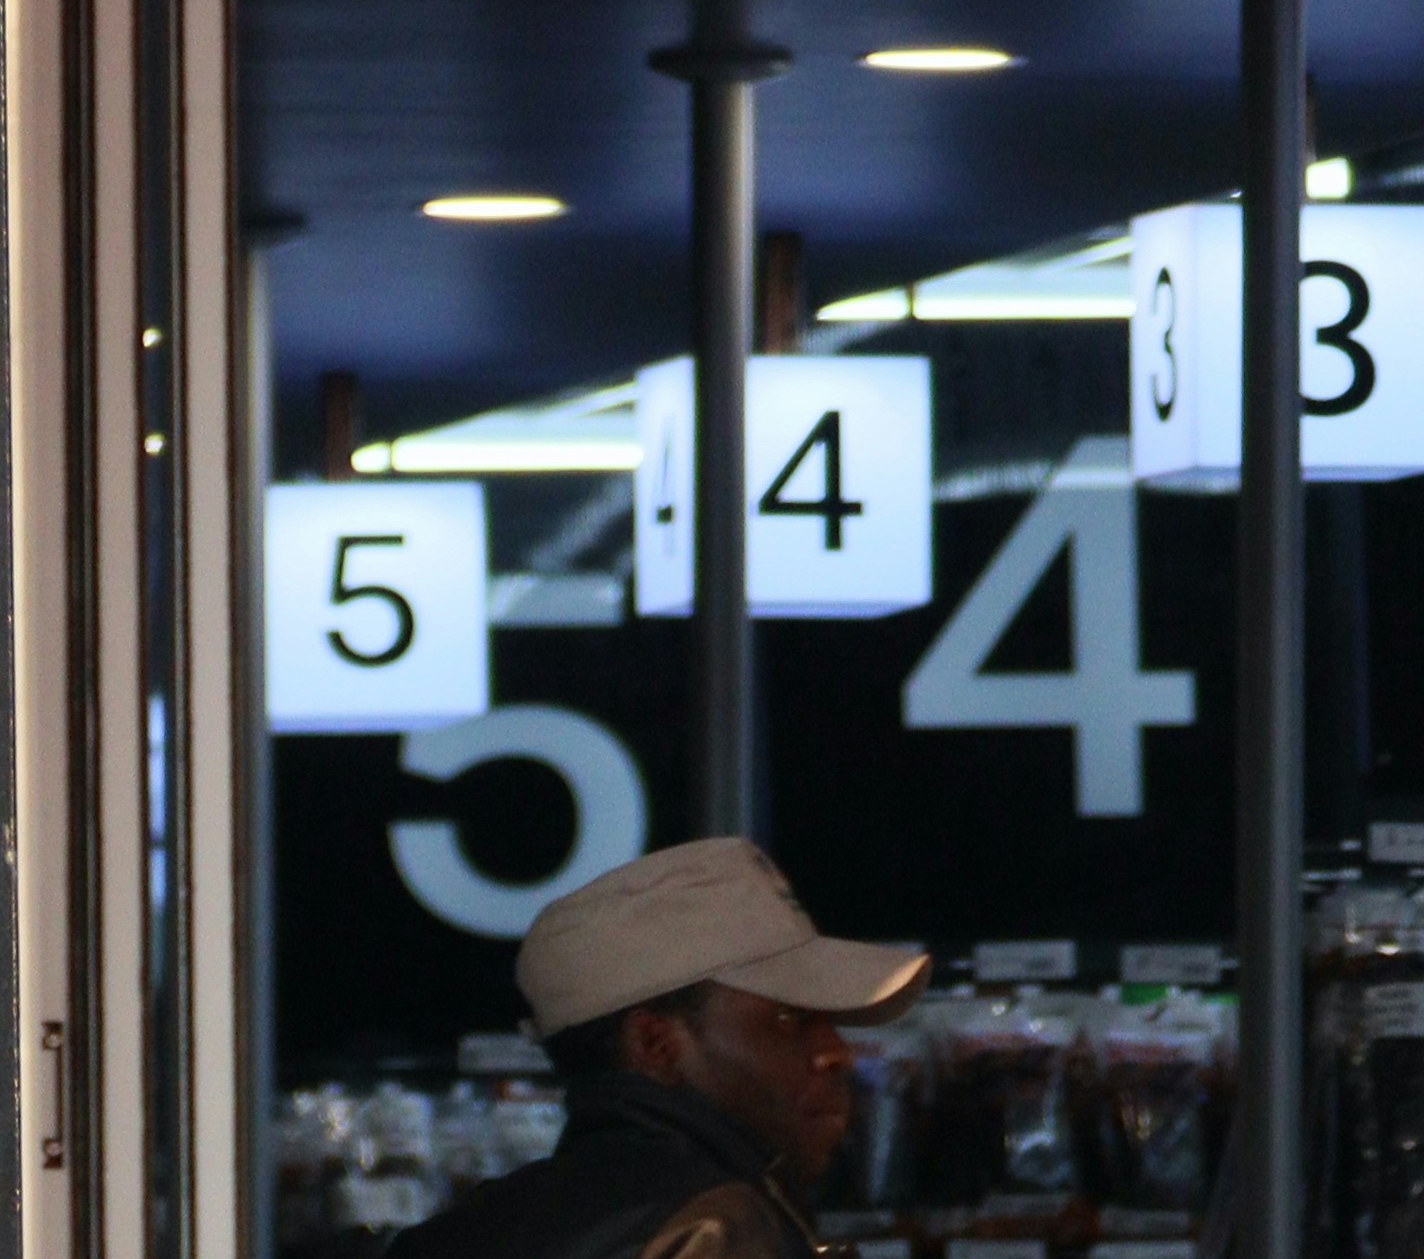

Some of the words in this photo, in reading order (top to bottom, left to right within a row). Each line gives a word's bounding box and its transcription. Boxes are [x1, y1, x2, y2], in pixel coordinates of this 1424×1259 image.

[1151, 267, 1177, 422] 3
[1299, 260, 1376, 417] 3
[758, 410, 863, 551] 4
[325, 534, 415, 668] 5
[902, 433, 1196, 818] 4
